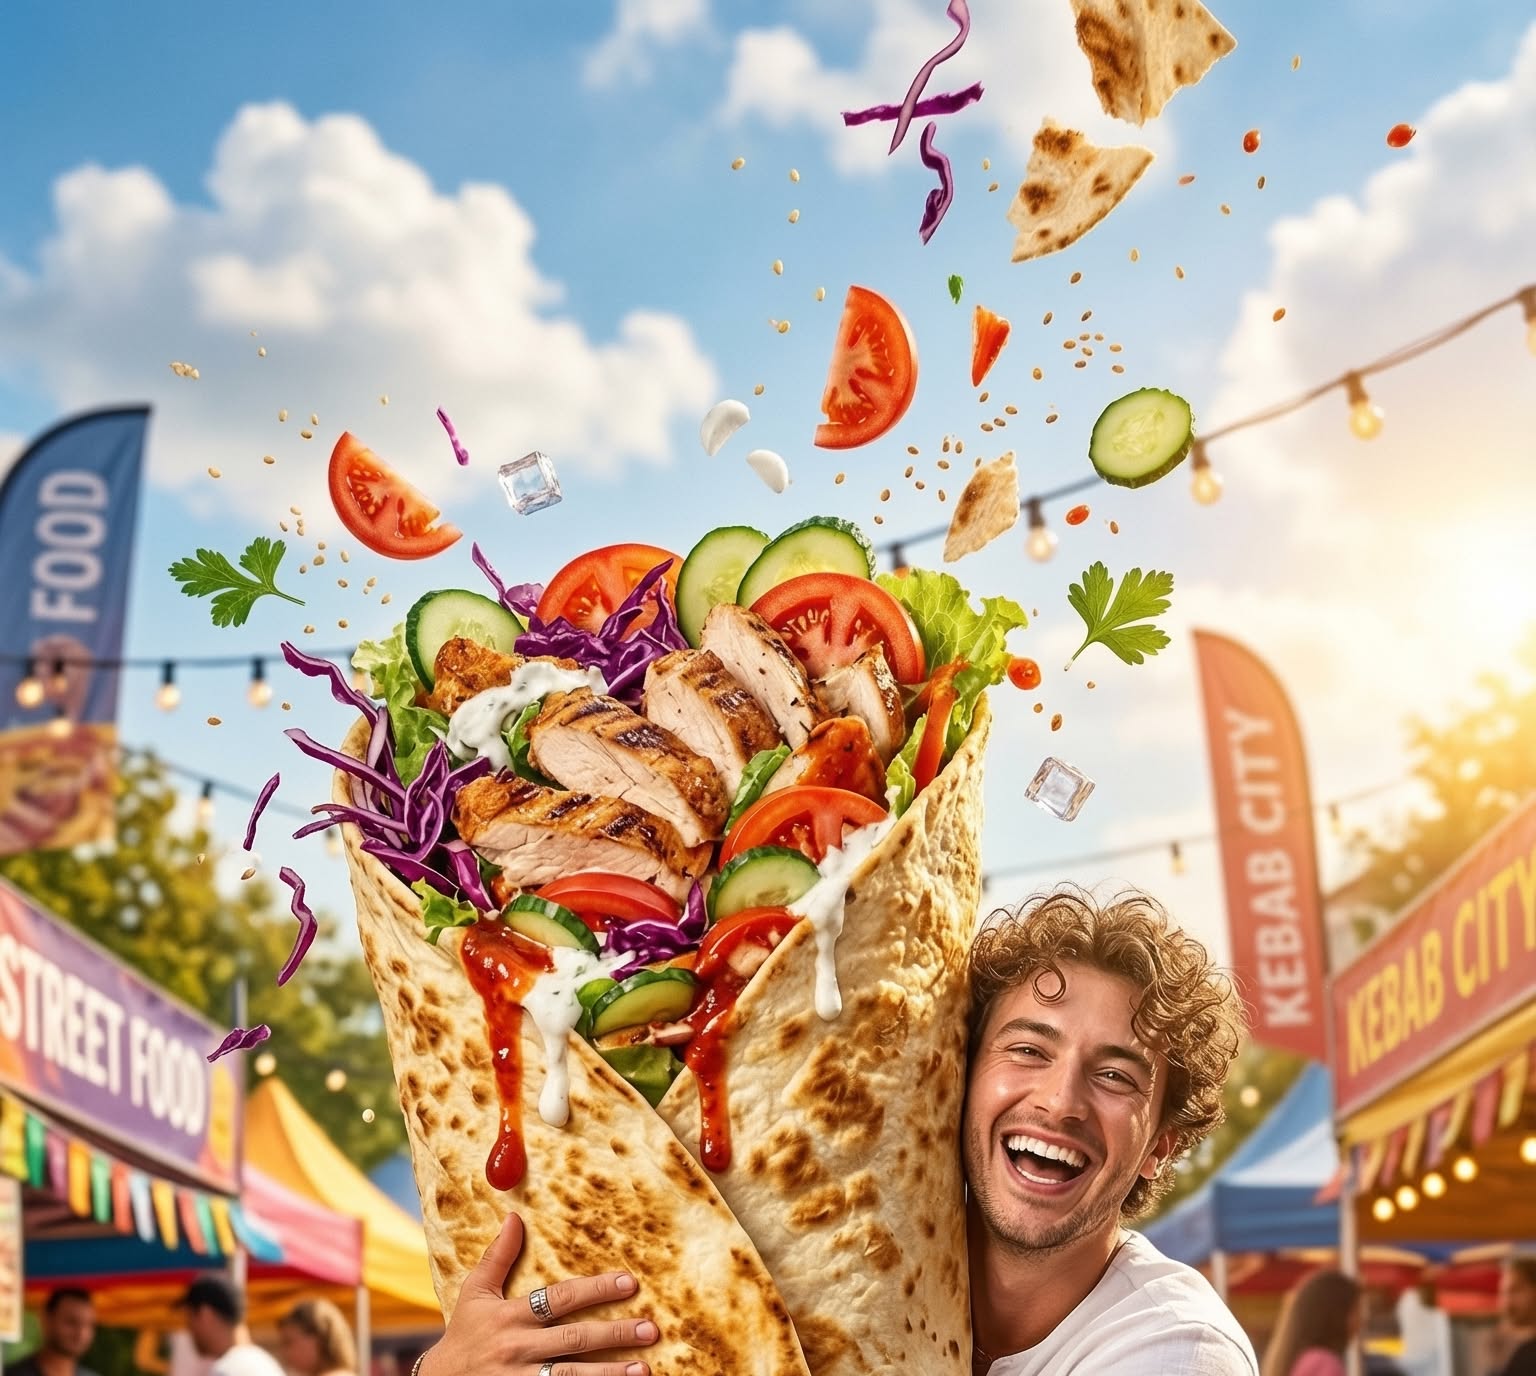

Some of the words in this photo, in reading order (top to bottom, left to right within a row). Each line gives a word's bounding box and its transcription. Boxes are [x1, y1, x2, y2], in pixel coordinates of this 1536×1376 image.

[31, 469, 107, 622] FOOD
[1222, 709, 1284, 836] CITY
[1244, 849, 1311, 1028] KEBAB
[1347, 931, 1444, 1077] KEBAB
[1453, 848, 1536, 998] CITY
[0, 934, 123, 1095] STREET
[130, 1015, 204, 1136] FOOD
